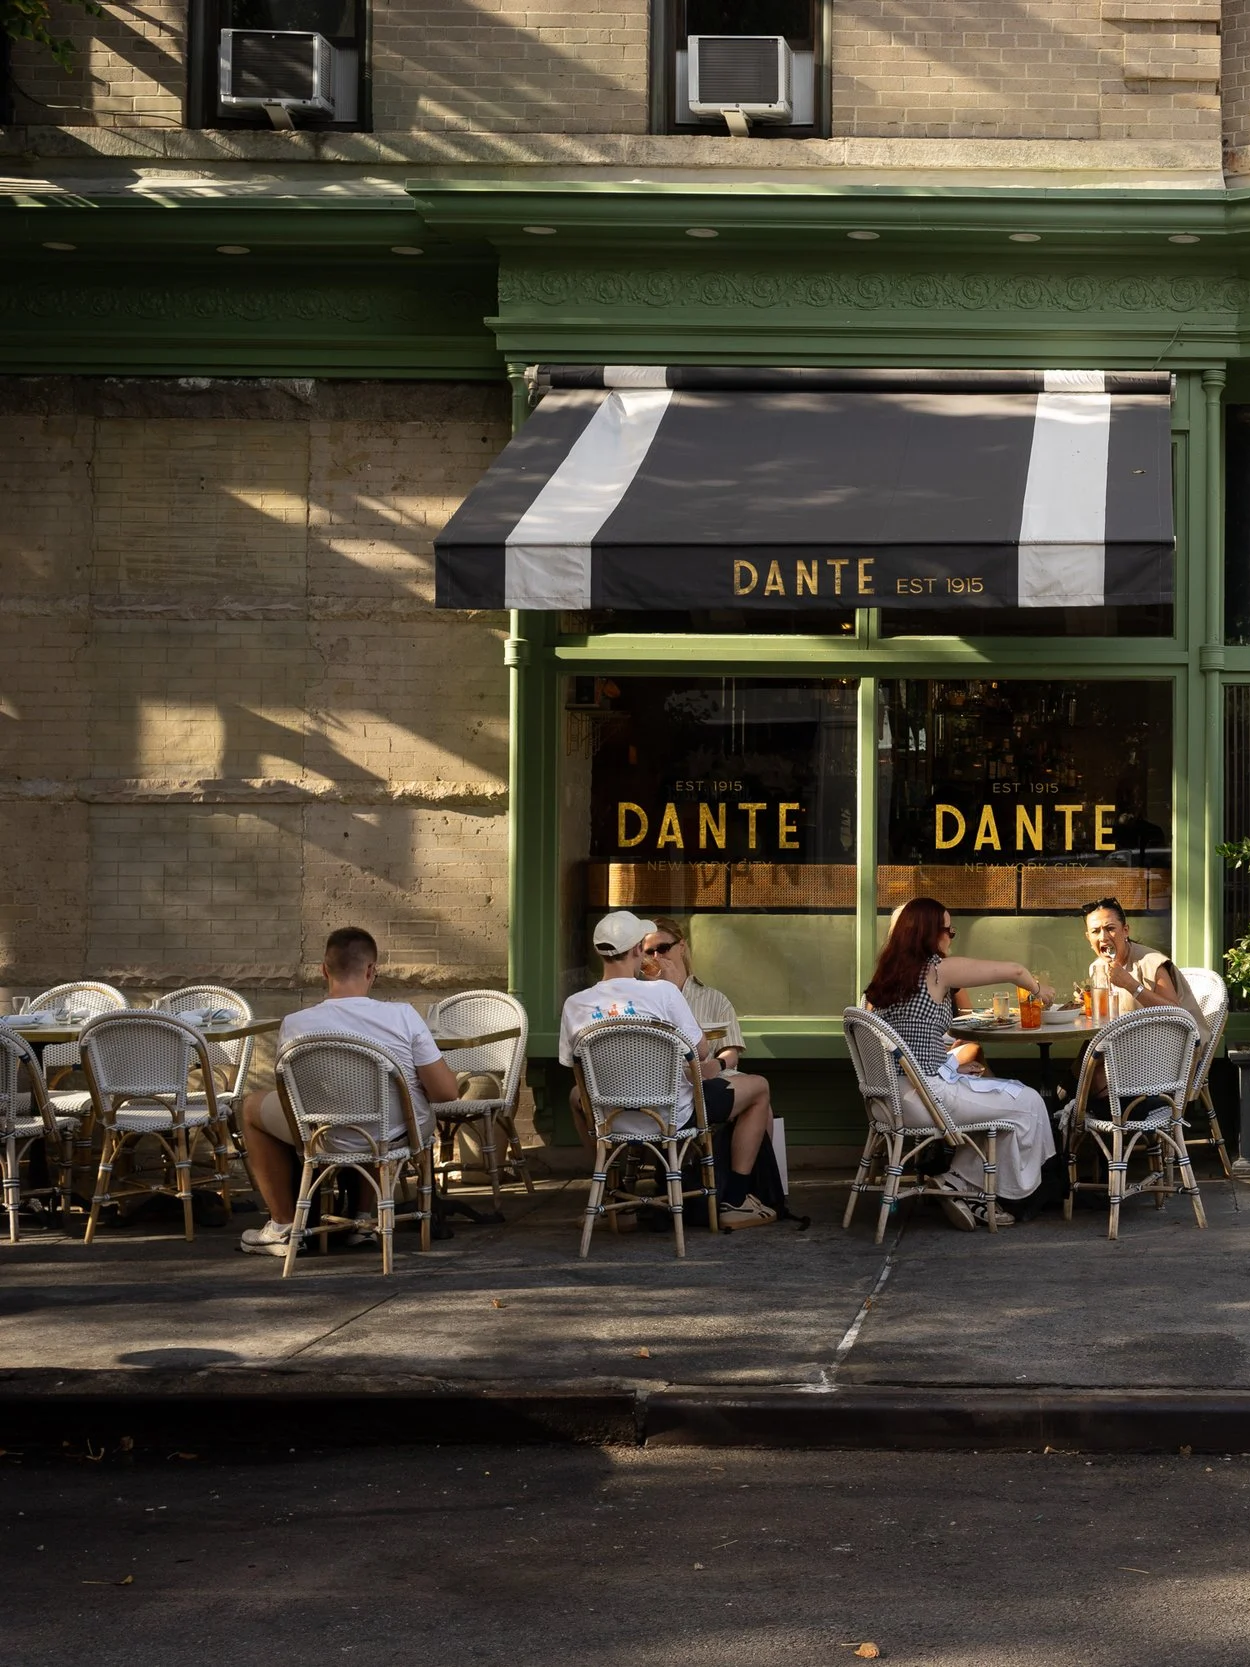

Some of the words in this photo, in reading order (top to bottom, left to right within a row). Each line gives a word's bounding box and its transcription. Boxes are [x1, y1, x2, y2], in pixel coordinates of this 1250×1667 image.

[733, 558, 875, 596] DANTE
[896, 578, 937, 594] EST
[946, 577, 984, 593] 1915
[713, 780, 743, 792] 1915
[1030, 783, 1059, 793] 1915
[618, 802, 800, 849] DANTE
[935, 804, 1116, 851] DANTE
[647, 860, 681, 871] NEW
[688, 860, 731, 871] YORK
[736, 860, 772, 871] CITY
[964, 862, 1000, 873] NEW
[1005, 862, 1047, 873] YORK
[1054, 862, 1088, 873] CITY
